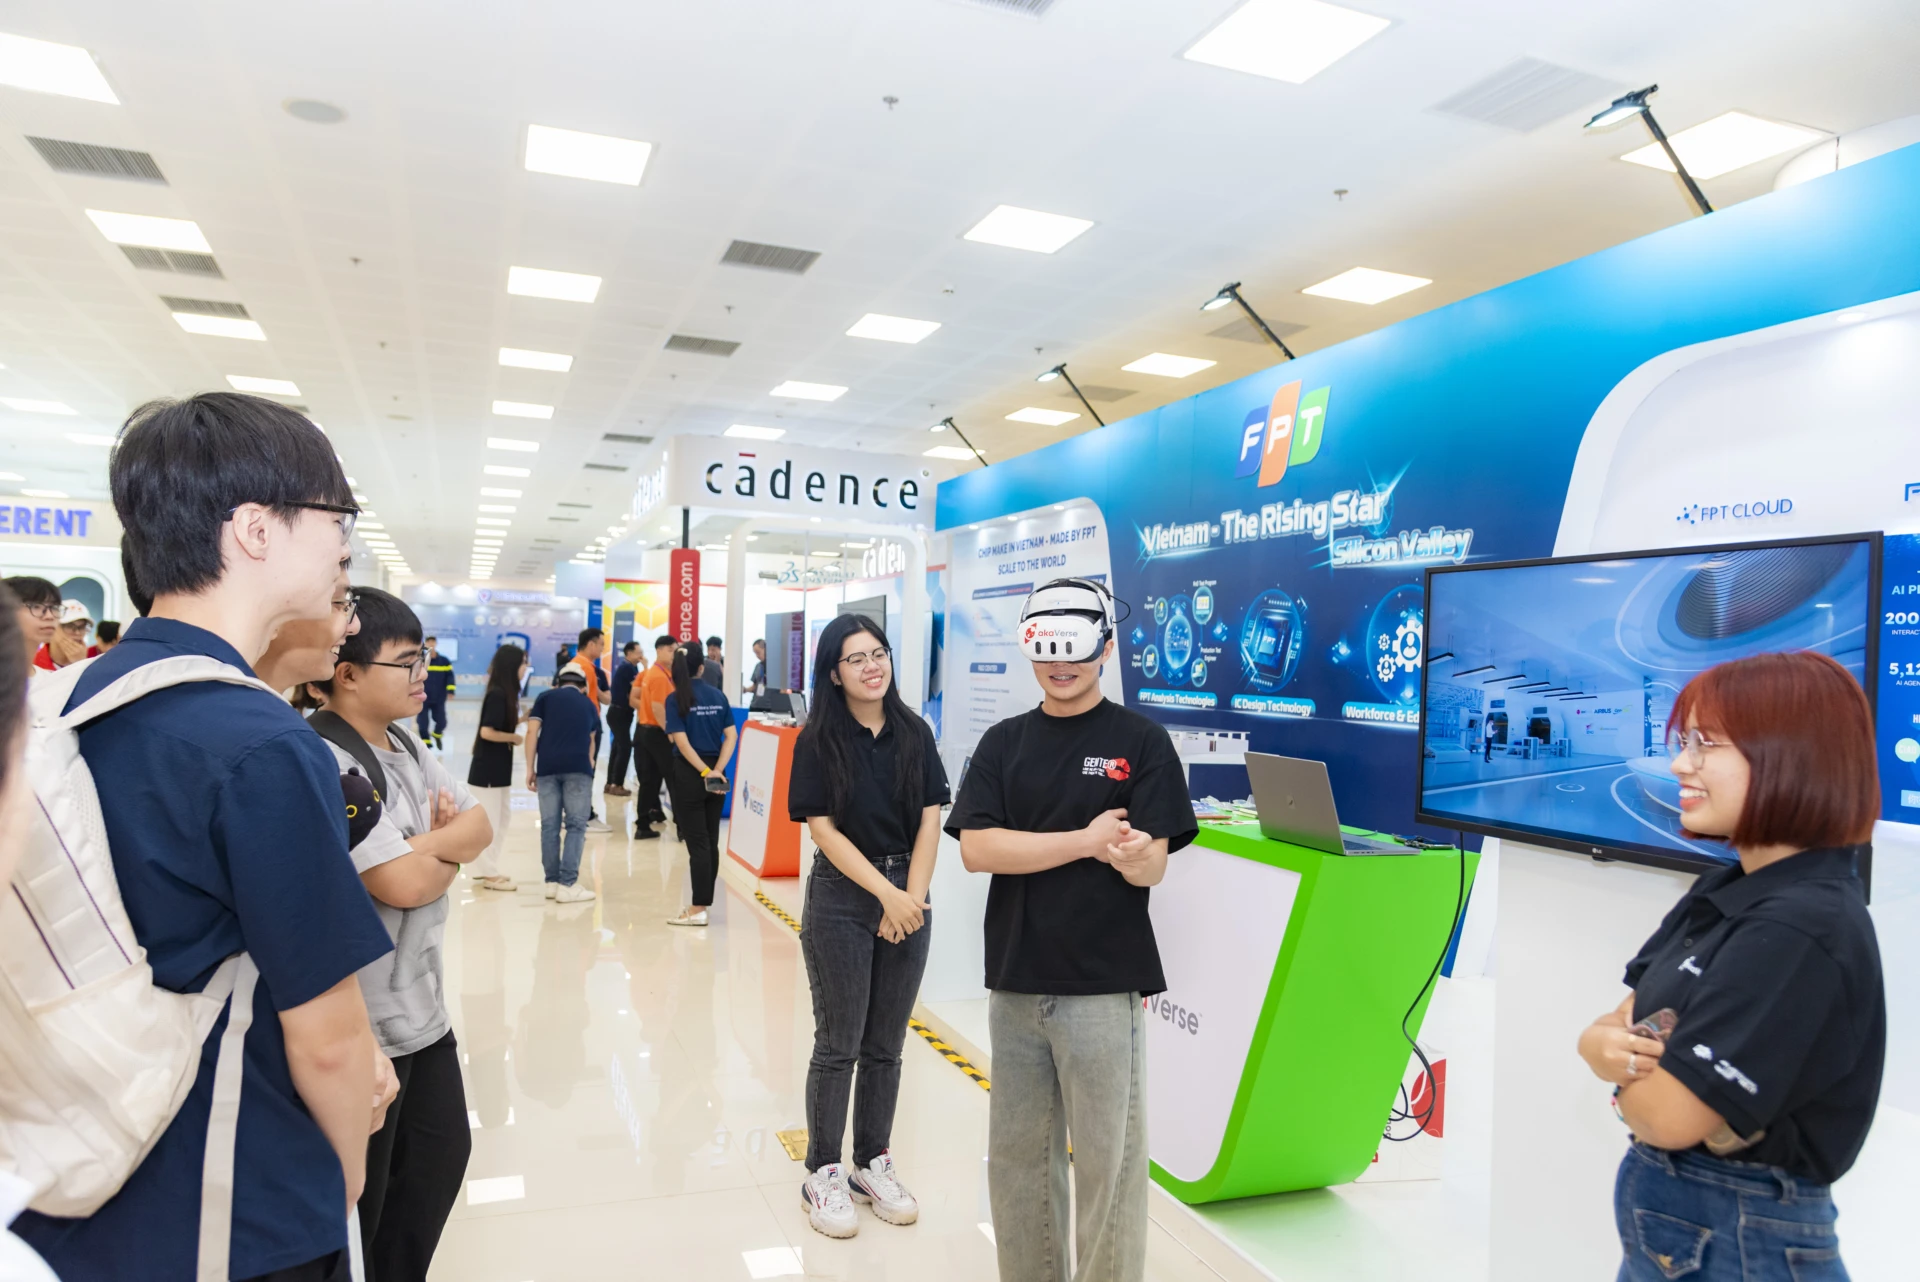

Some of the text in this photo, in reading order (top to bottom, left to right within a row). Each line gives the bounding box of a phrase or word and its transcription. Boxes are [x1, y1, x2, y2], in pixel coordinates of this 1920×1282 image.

[1239, 402, 1324, 466] FPT
[1701, 499, 1793, 521] FPT CLOUD
[0, 505, 92, 538] ERENT
[1144, 521, 1209, 552] Vietnam
[1221, 510, 1258, 543] The
[1261, 499, 1328, 539] Rising
[1331, 491, 1387, 526] Star
[978, 548, 991, 558] CHIP
[992, 543, 1008, 556] MAKE
[1008, 541, 1016, 553] IN
[1017, 536, 1044, 552] VIETNAM
[1050, 531, 1069, 545] MADE
[1071, 529, 1081, 541] BY
[1082, 526, 1096, 539] FPT
[1332, 527, 1472, 567] Silicon Valley
[998, 554, 1067, 575] SCALE TO THE WORLD
[1892, 585, 1905, 595] AI
[680, 562, 693, 644] ence.com
[1885, 612, 1919, 625] 200
[1038, 628, 1078, 637] akaVerse
[1140, 692, 1215, 708] FPT Analysis Technologies
[1234, 698, 1312, 717] IC Design Technology
[1346, 706, 1395, 721] Workforce
[1396, 710, 1405, 722] &
[1143, 994, 1198, 1035] Verse
